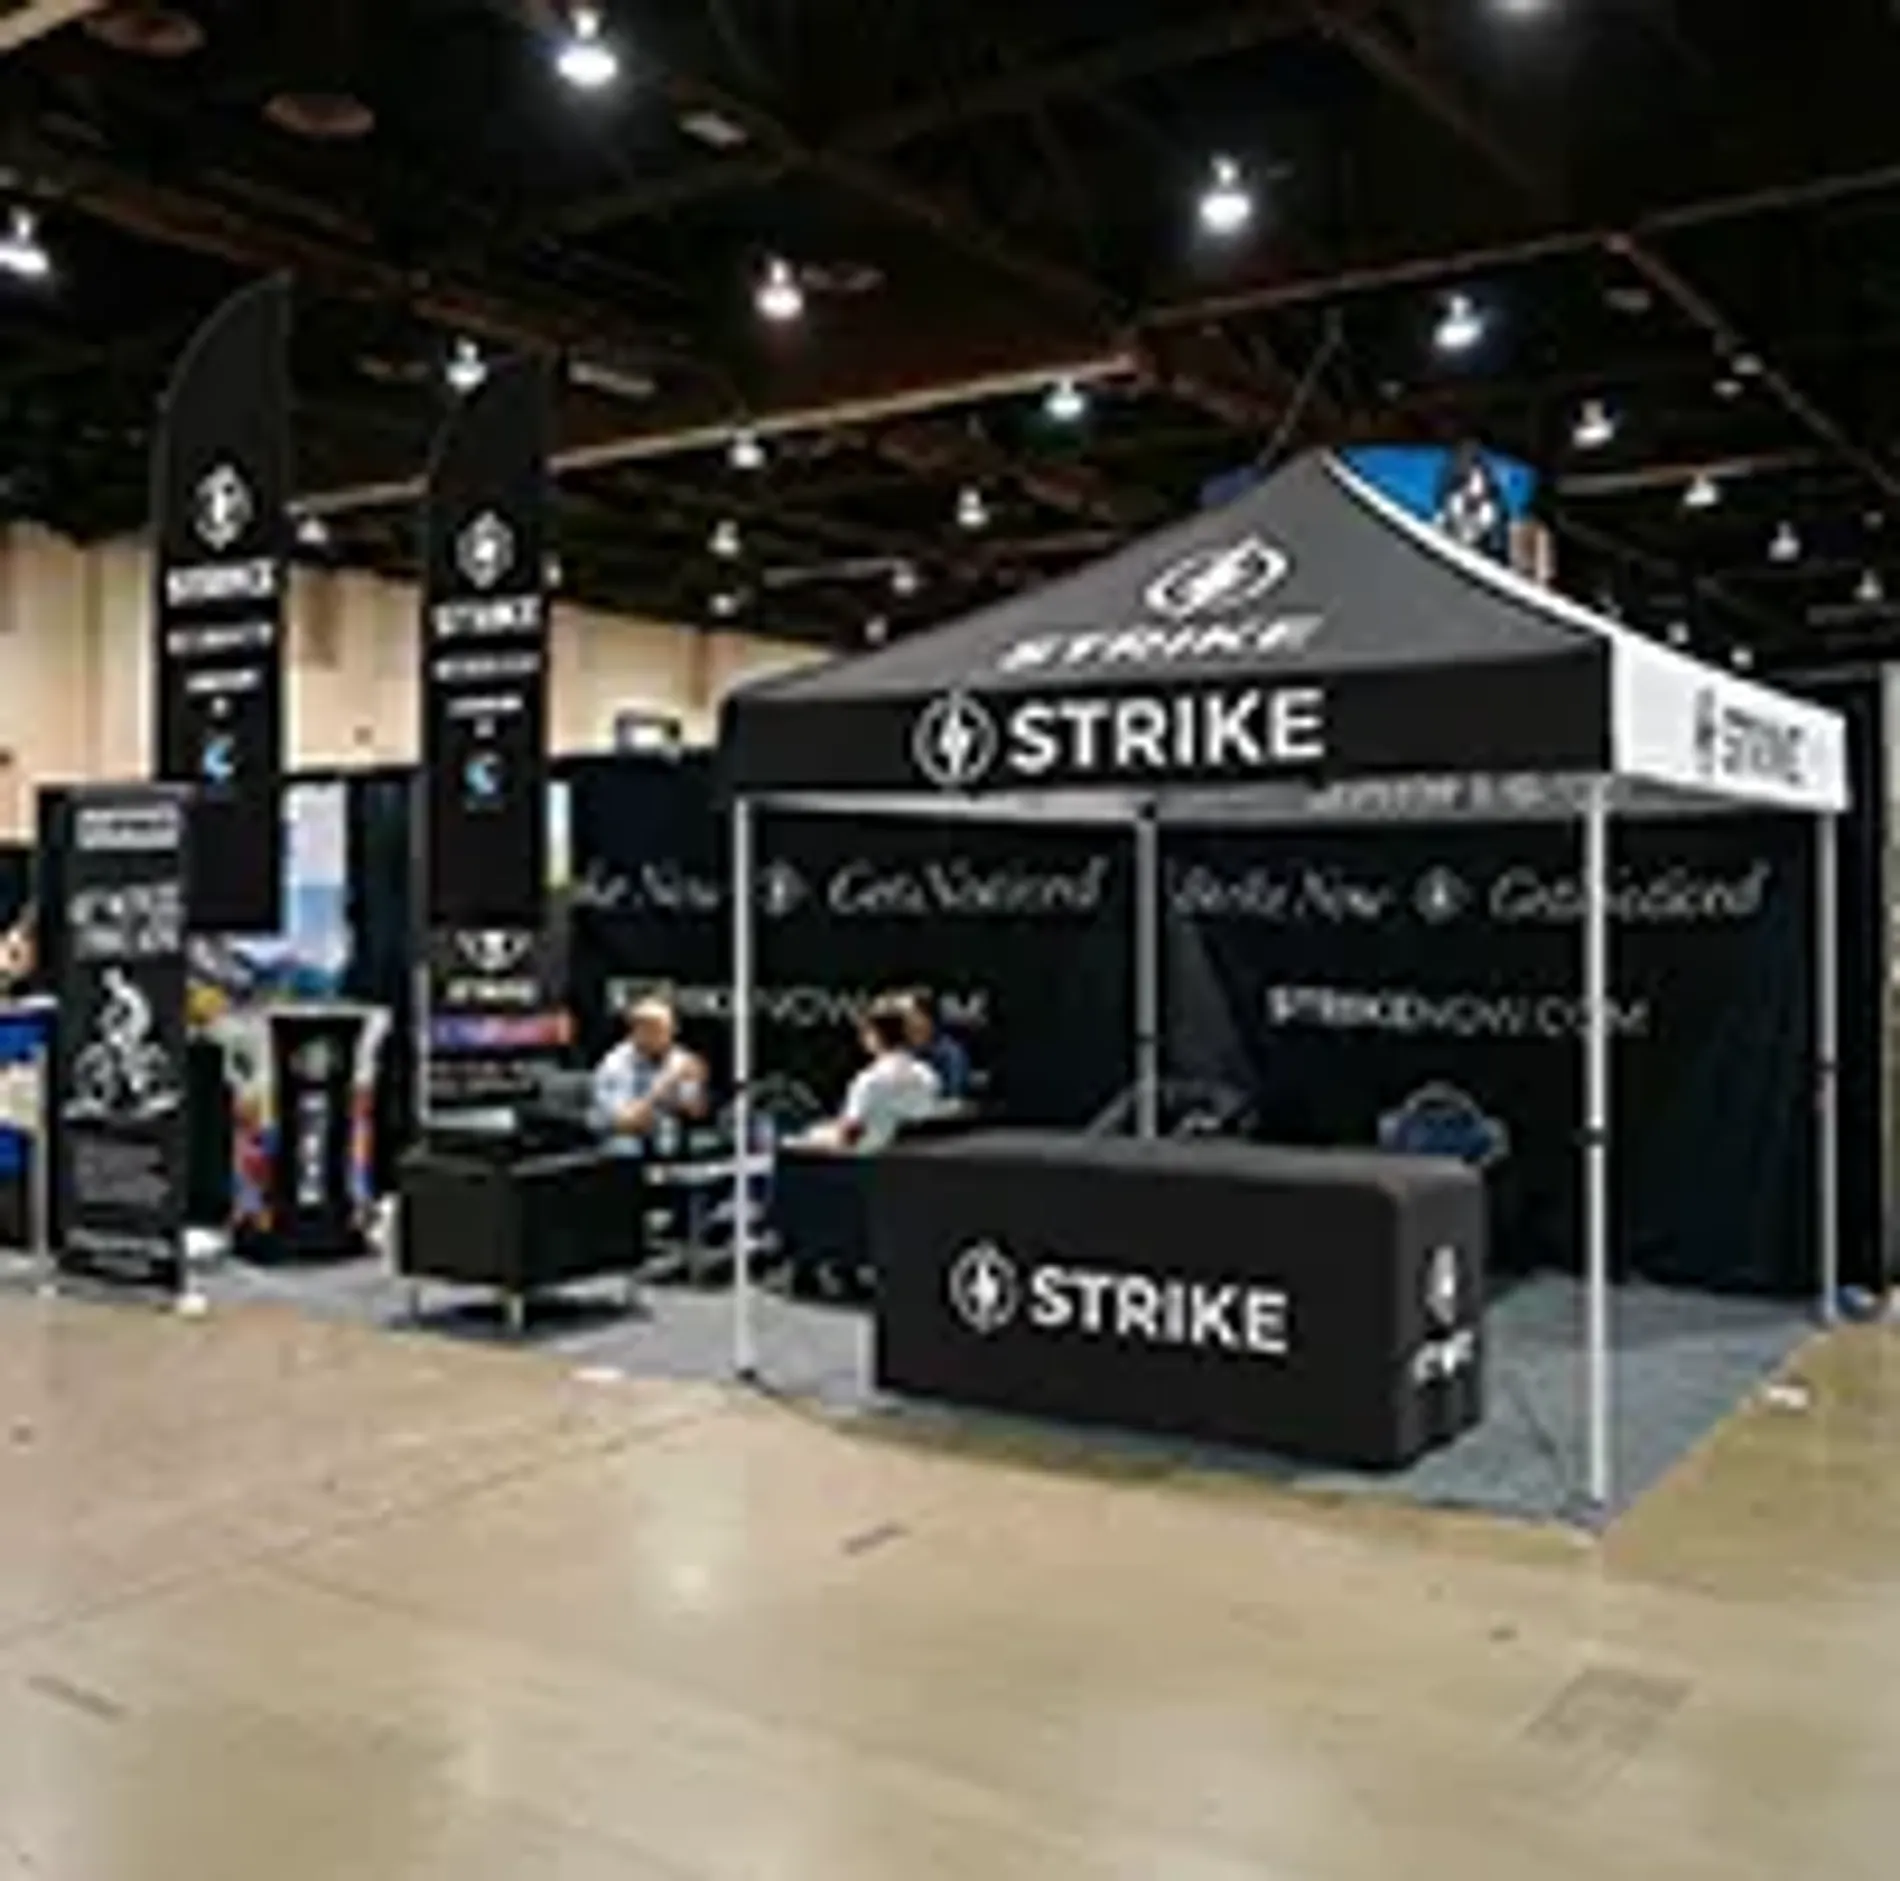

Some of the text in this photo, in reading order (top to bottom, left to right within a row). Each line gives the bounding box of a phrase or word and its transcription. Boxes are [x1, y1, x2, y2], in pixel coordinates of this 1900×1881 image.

[994, 614, 1324, 674] STRIKE
[1008, 688, 1326, 775] STRIKE
[1030, 1264, 1289, 1354] STRIKE
